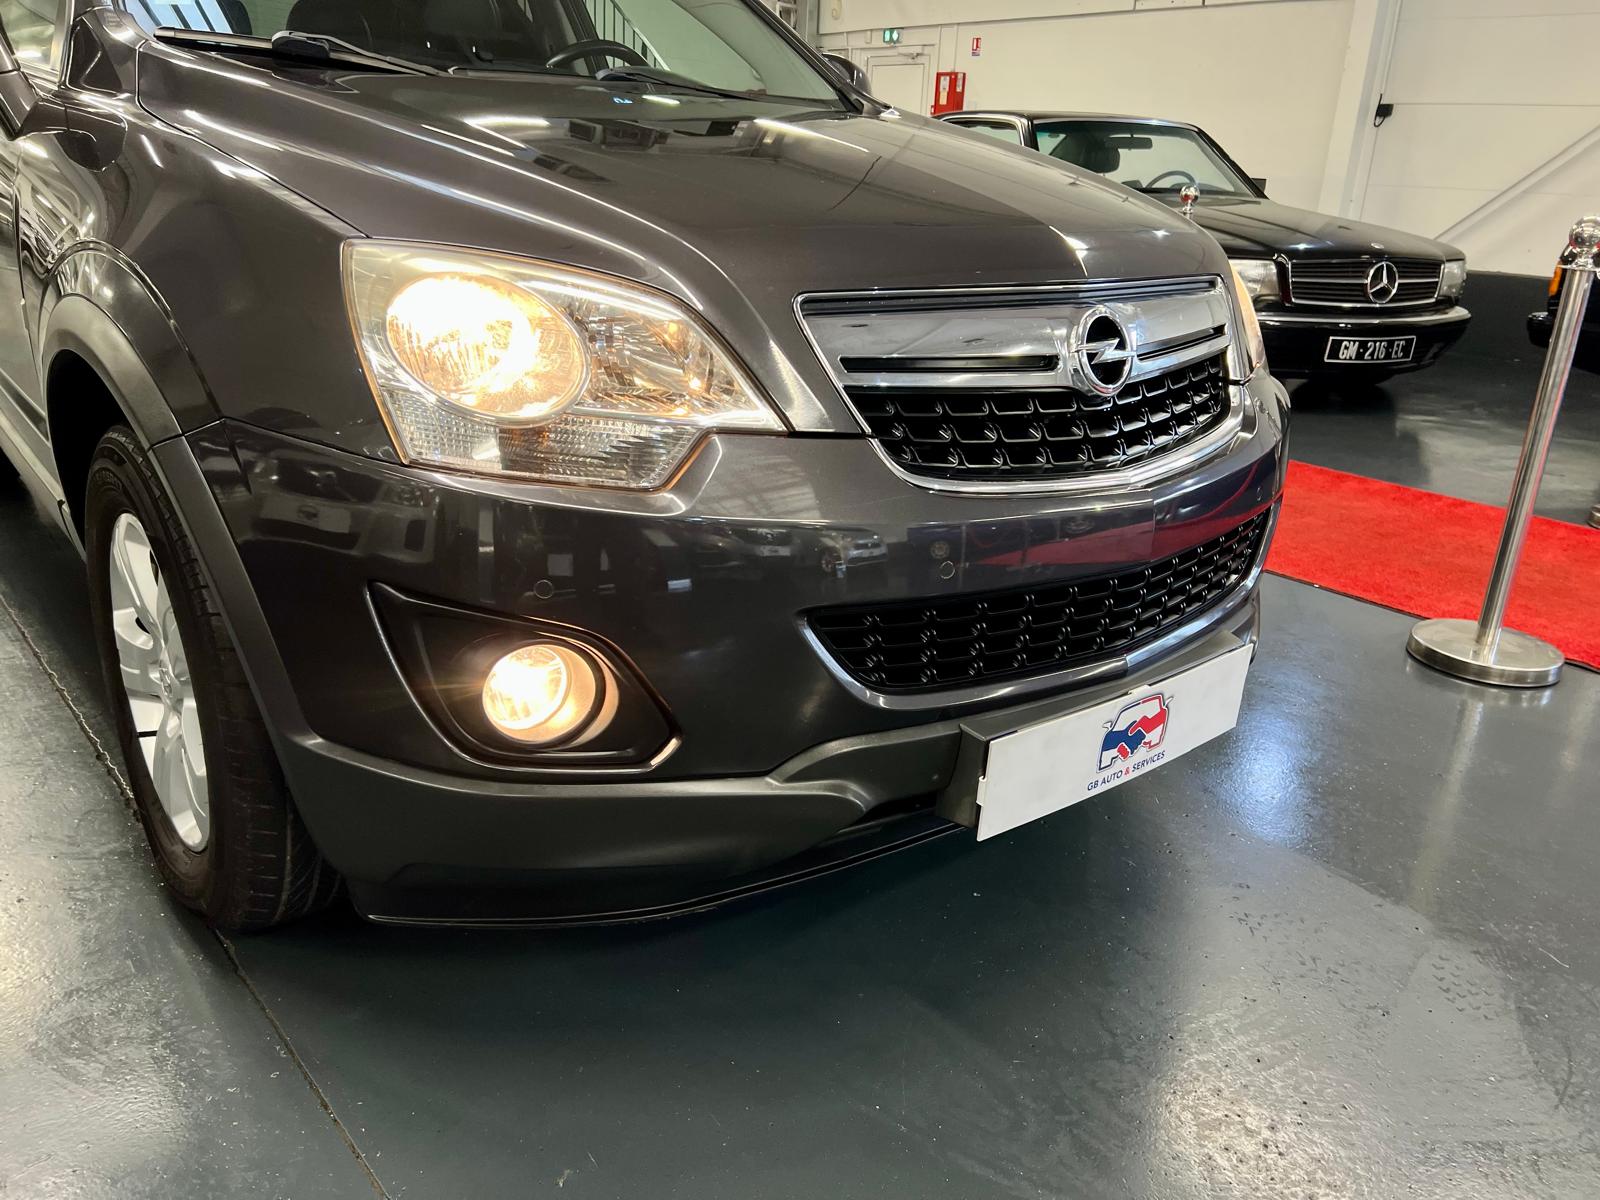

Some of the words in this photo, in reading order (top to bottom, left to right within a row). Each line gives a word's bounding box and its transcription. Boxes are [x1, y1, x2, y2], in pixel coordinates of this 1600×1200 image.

[1087, 780, 1099, 791] GB
[1100, 770, 1123, 786] AUTO
[1124, 766, 1130, 776] &
[1132, 751, 1165, 772] SERVICES
